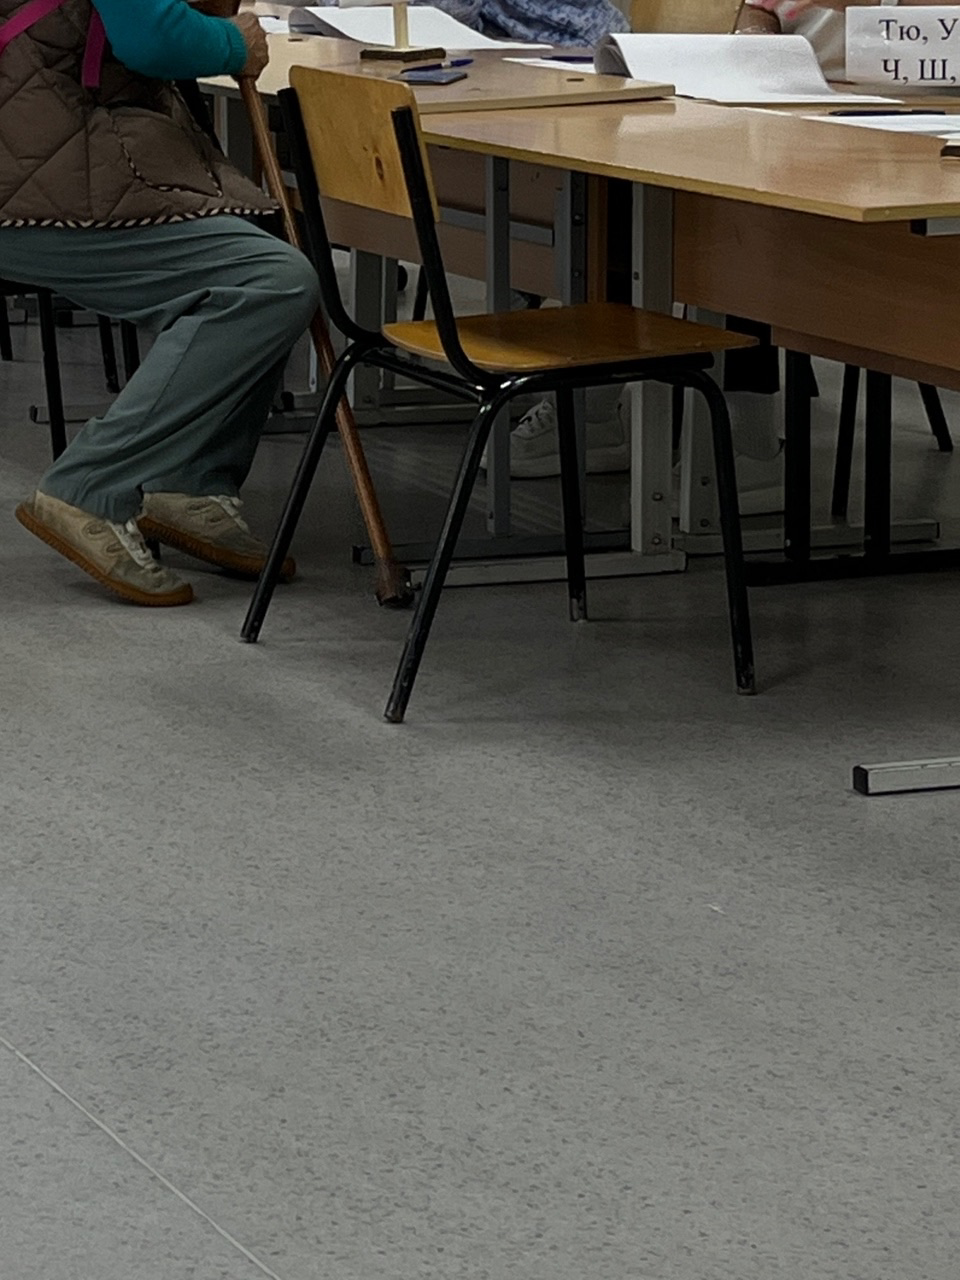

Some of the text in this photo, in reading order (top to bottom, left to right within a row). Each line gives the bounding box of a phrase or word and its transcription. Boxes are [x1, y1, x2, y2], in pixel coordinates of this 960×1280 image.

[878, 19, 929, 45] Тю,
[881, 58, 957, 85] Ч, Ш,
